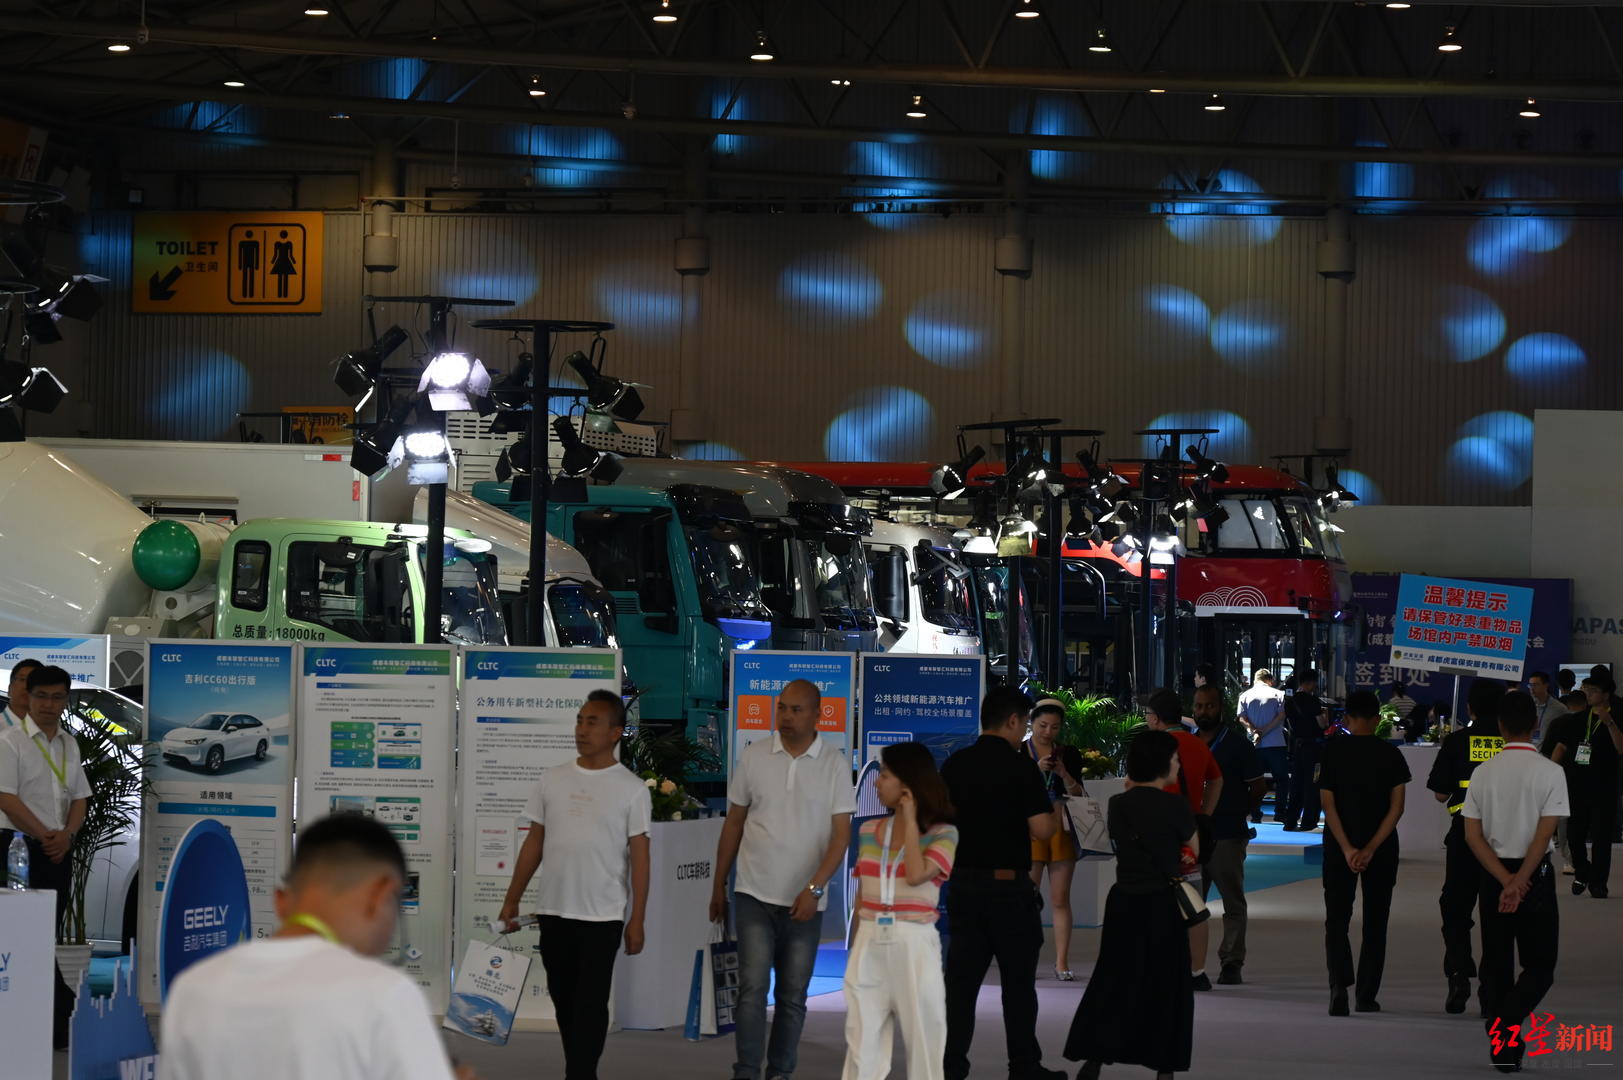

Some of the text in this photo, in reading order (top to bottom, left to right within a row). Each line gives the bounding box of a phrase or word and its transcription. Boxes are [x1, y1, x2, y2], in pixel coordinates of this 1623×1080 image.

[155, 240, 218, 255] TOILET
[184, 261, 218, 273] 卫生间
[1423, 584, 1509, 612] 温馨提示
[1403, 607, 1523, 635] 请保管好贵重物品
[1407, 626, 1513, 652] 场馆内严禁吸烟
[161, 653, 182, 663] CLTC
[315, 658, 337, 668] CLTC
[1427, 655, 1520, 673] 成都虎富保安服务有限公司
[476, 661, 499, 671] CLTC
[743, 662, 761, 670] CLTC
[184, 673, 257, 686] 吉利CC60出行版
[1355, 661, 1431, 687] 签到处
[874, 693, 973, 706] 公共领域新能源汽车推广
[199, 790, 233, 800] 适用领域
[183, 904, 229, 930] GEELY
